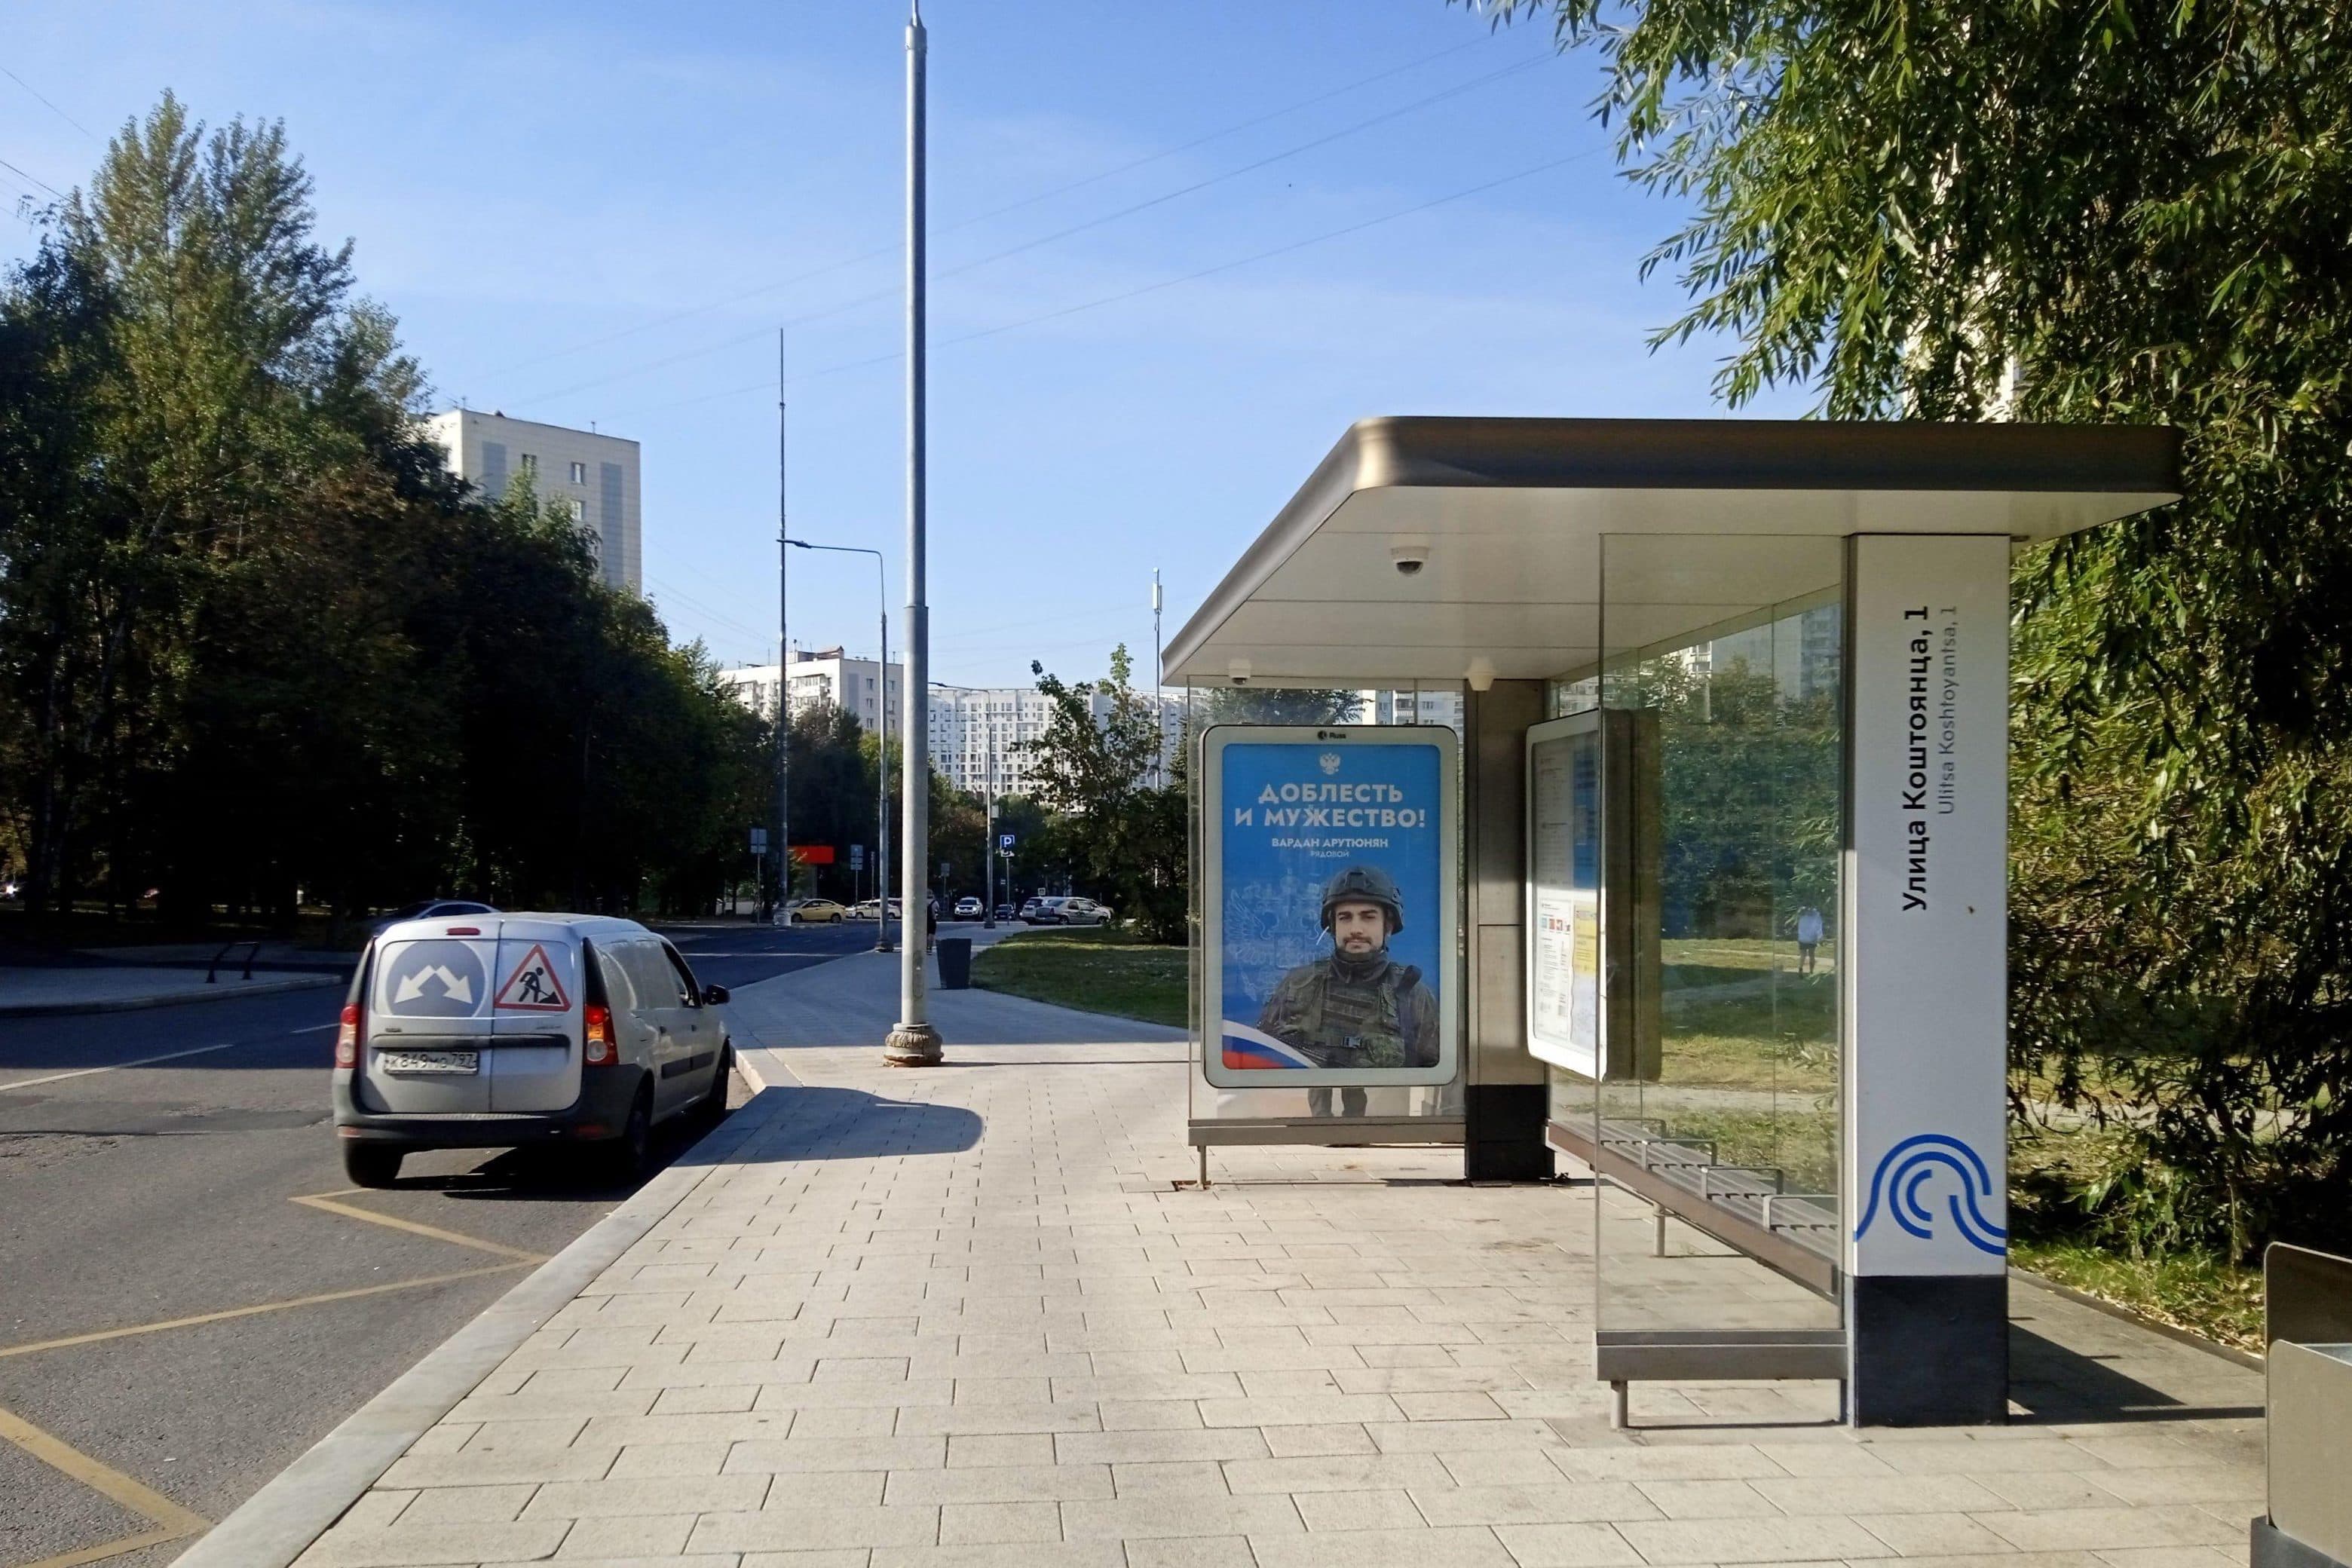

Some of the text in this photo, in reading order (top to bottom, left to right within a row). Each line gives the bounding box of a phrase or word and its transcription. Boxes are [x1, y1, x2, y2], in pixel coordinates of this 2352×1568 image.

[1937, 605, 1960, 815] Ulitsa Koshtoyantsa, 1
[1902, 605, 1934, 911] Улица Коштоянца, 1
[1257, 782, 1404, 804] ДОБЛЕСТЬ
[1234, 807, 1426, 828] И МУЖЕСТВО!
[1271, 838, 1389, 849] ВАРДАН АРУТЮНЯН
